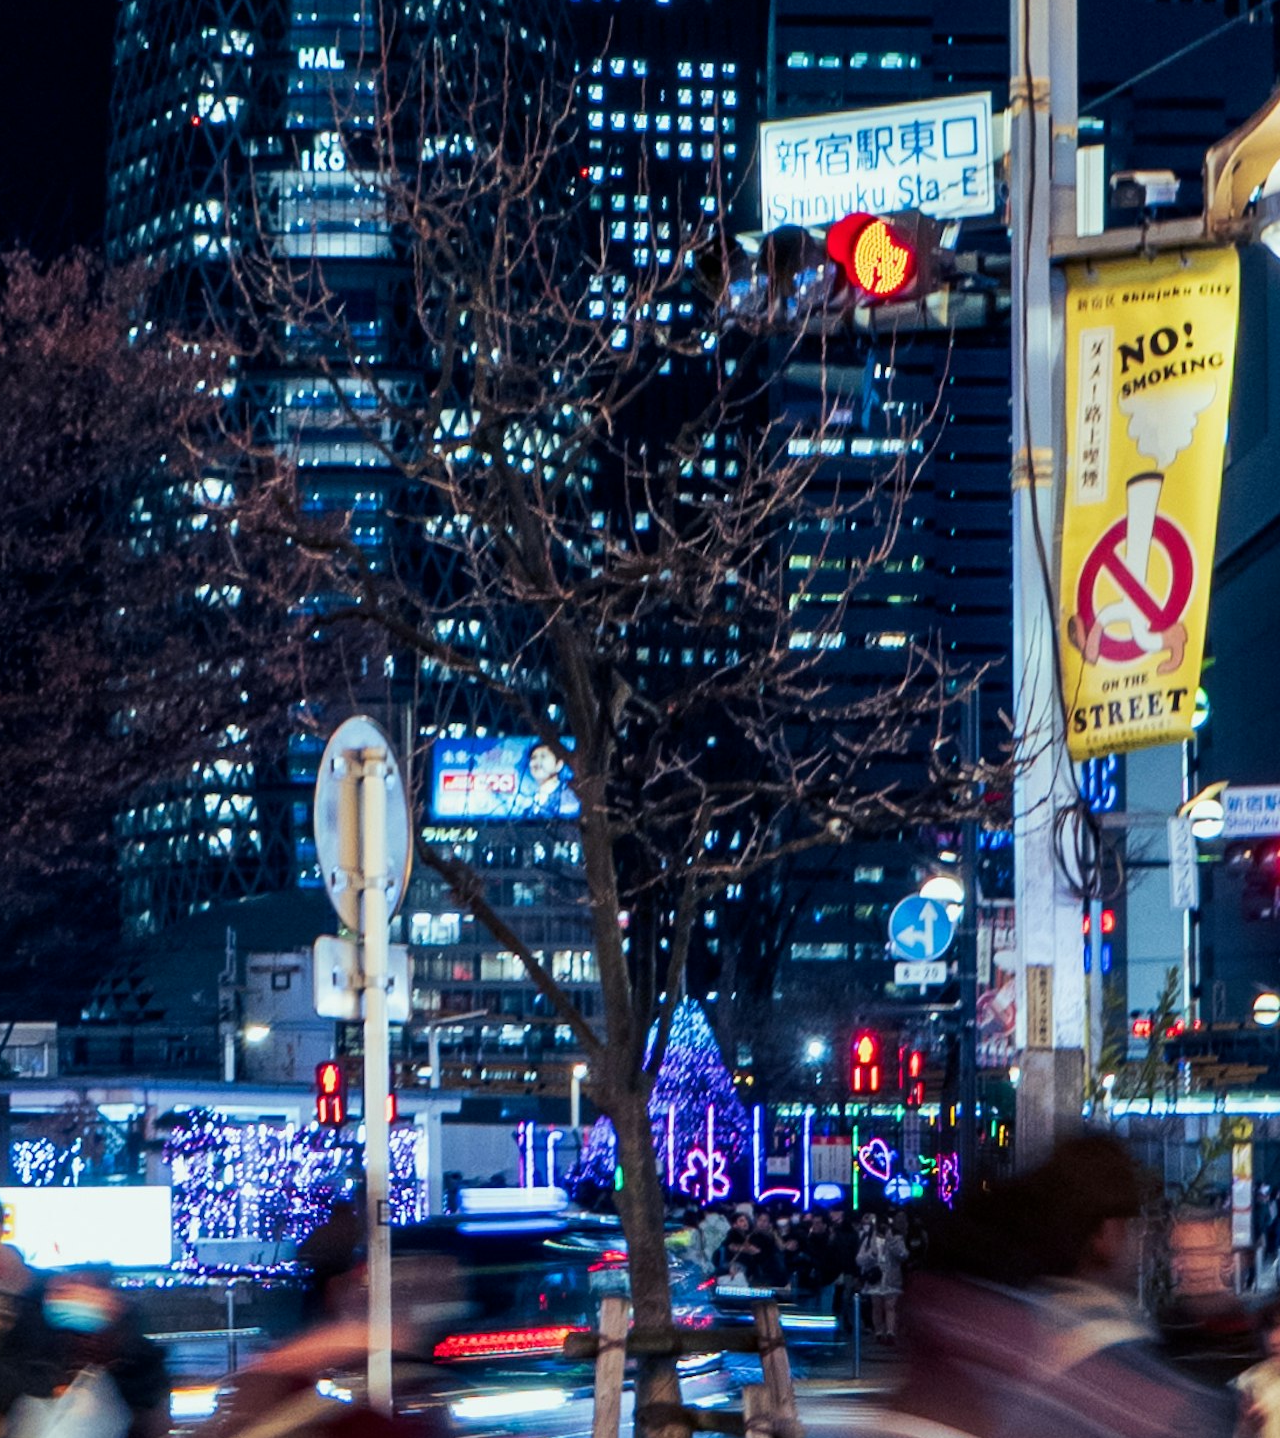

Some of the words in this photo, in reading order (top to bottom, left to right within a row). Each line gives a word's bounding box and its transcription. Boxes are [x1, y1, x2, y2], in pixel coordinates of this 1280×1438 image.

[776, 116, 978, 178] 新宿駅東口
[773, 182, 885, 222] Shinjuku
[1117, 322, 1194, 374] NO!
[1121, 352, 1225, 399] SMOKING
[1102, 679, 1119, 693] ON
[1124, 673, 1149, 689] THE
[1073, 687, 1188, 734] STREET
